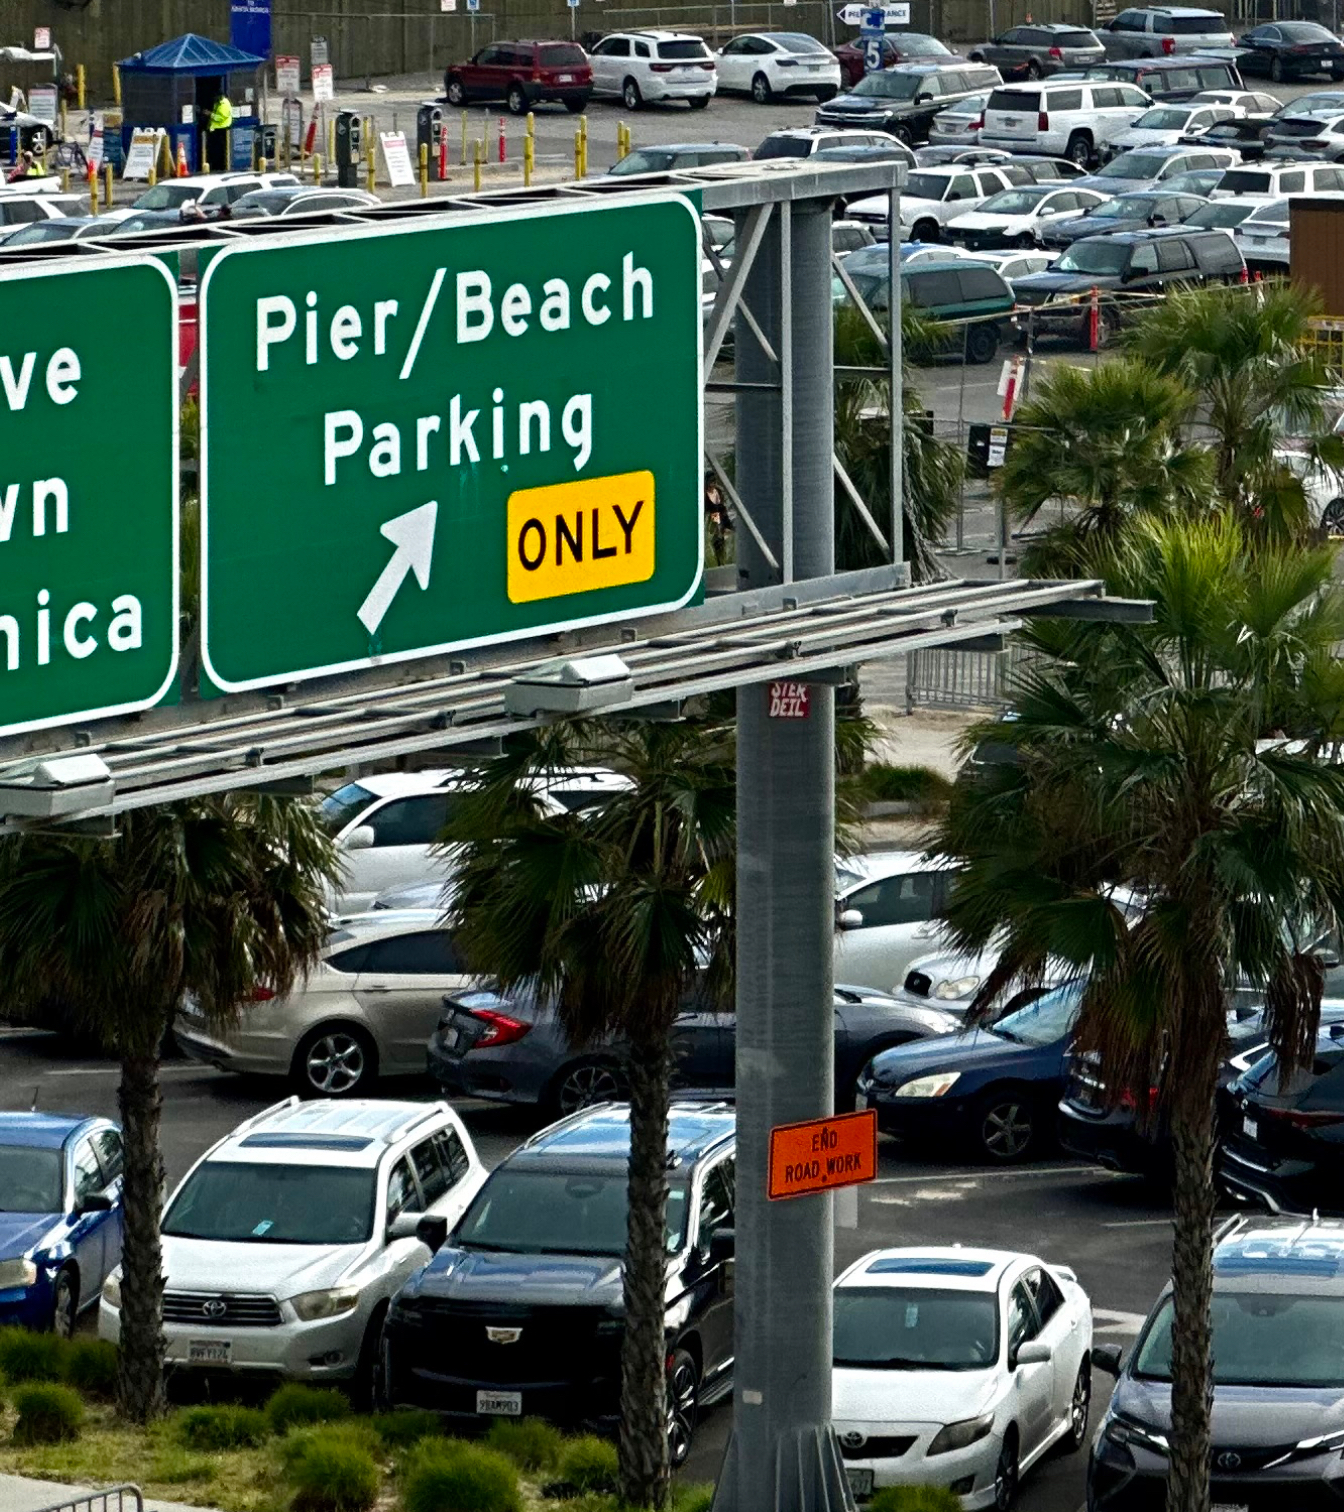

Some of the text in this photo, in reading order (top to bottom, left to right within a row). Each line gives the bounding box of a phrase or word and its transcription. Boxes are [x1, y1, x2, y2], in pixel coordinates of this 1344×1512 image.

[866, 41, 880, 69] 5
[256, 251, 654, 379] Pier/Beach
[0, 347, 82, 411] ve
[324, 388, 594, 486] Parking
[517, 500, 645, 572] ONLY
[785, 1152, 861, 1183] ROAD WORK
[812, 1130, 838, 1152] END
